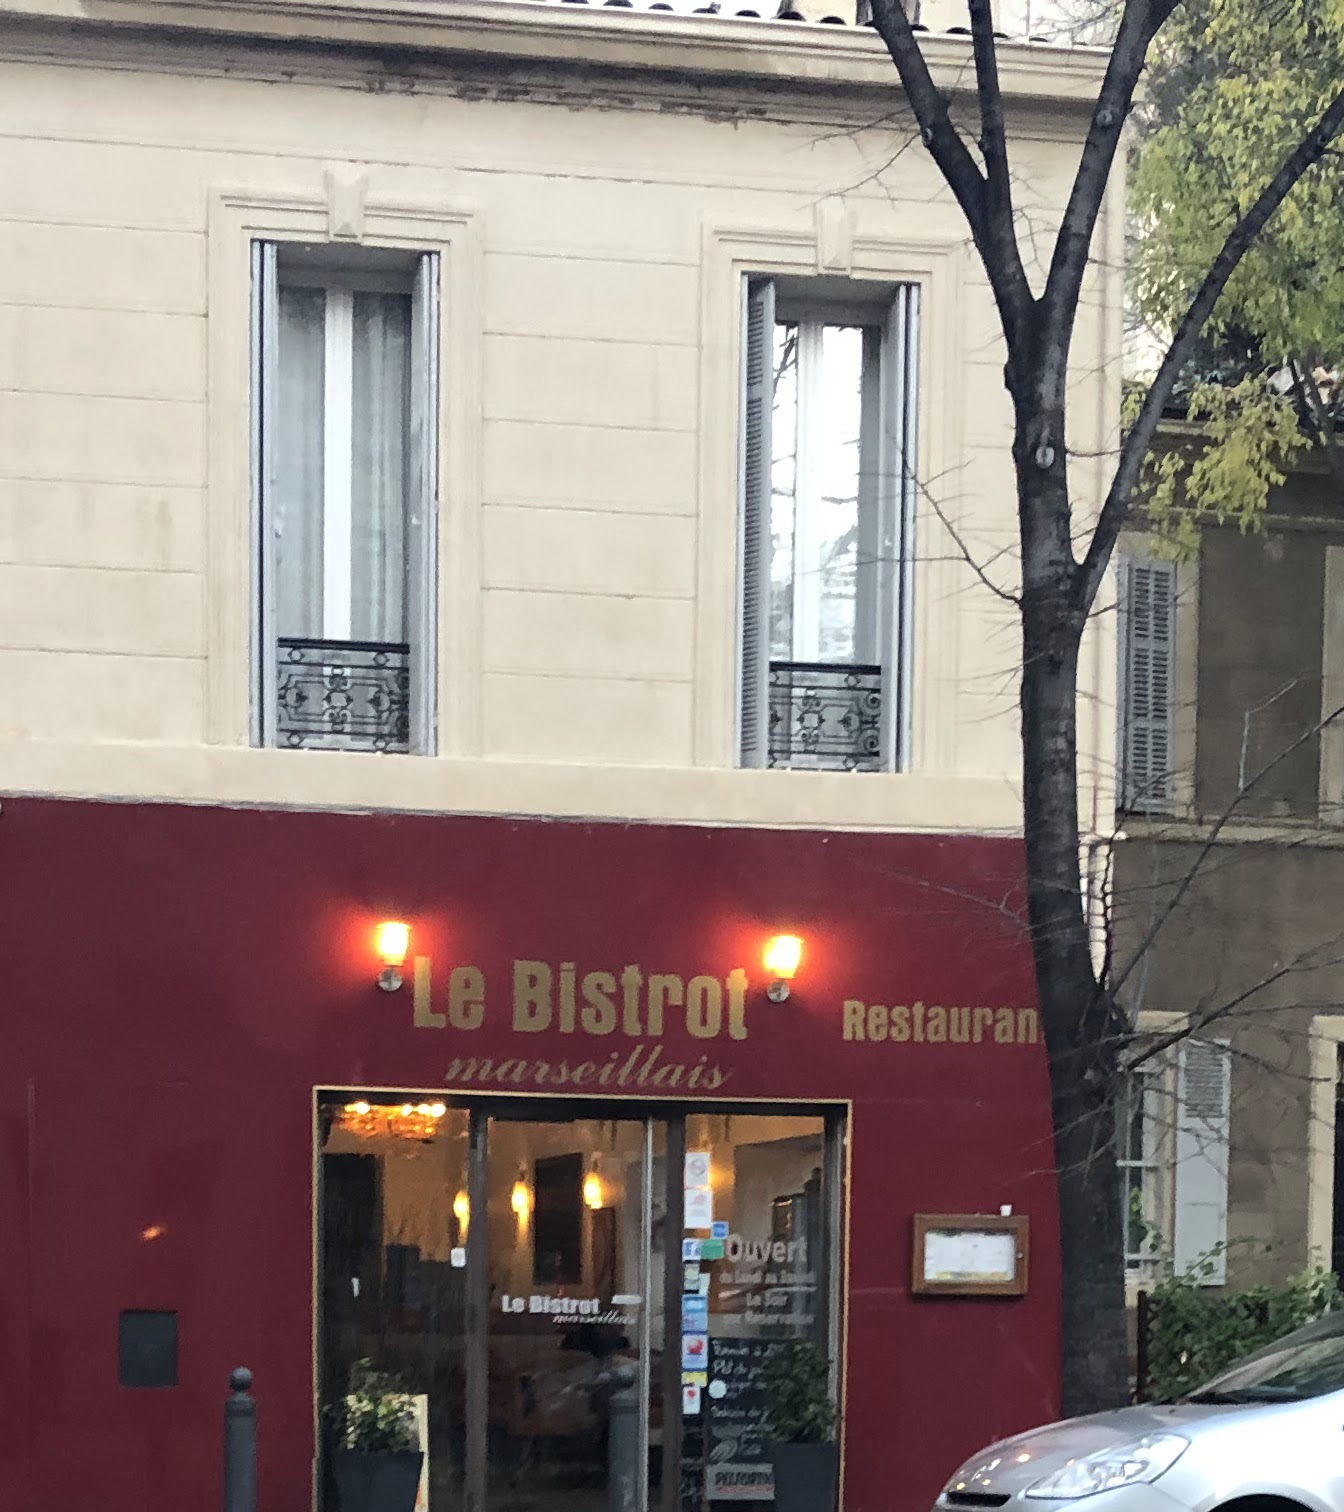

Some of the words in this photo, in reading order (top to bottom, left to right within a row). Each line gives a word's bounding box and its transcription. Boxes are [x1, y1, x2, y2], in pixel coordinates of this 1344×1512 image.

[413, 956, 485, 1030] Le
[512, 959, 748, 1041] Bistrot
[843, 1000, 1045, 1045] Restauran
[444, 1045, 733, 1090] marseillais
[725, 1233, 807, 1265] Ouvert
[502, 1294, 525, 1313] Le
[529, 1295, 600, 1314] Bistrot
